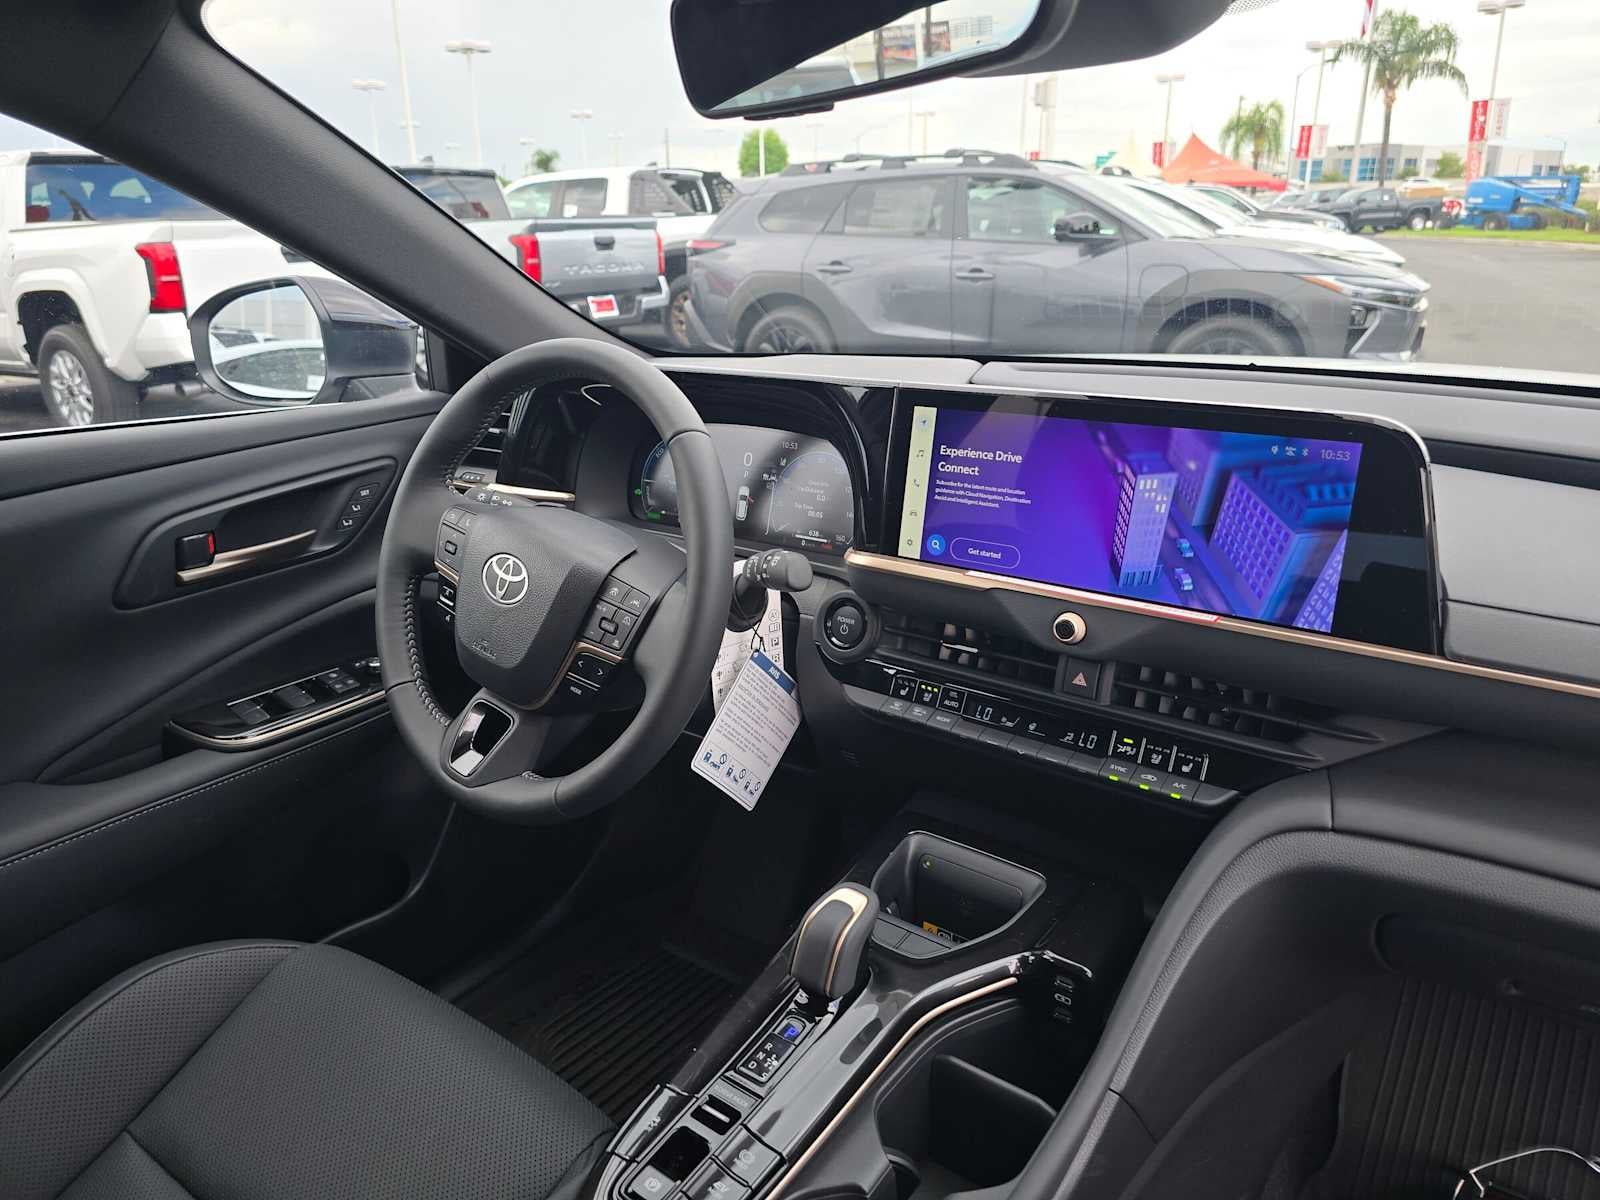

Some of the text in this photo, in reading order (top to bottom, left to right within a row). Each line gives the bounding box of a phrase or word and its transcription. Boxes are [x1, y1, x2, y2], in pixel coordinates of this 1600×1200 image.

[744, 452, 752, 467] 0
[940, 445, 1022, 463] Experience Drive
[1320, 449, 1351, 461] 10:53
[938, 461, 980, 475] Connect
[968, 547, 1001, 559] Get started
[943, 700, 959, 708] AUTO
[1078, 732, 1098, 749] LO
[764, 1042, 773, 1051] R
[756, 1051, 767, 1060] N
[748, 1061, 757, 1069] D
